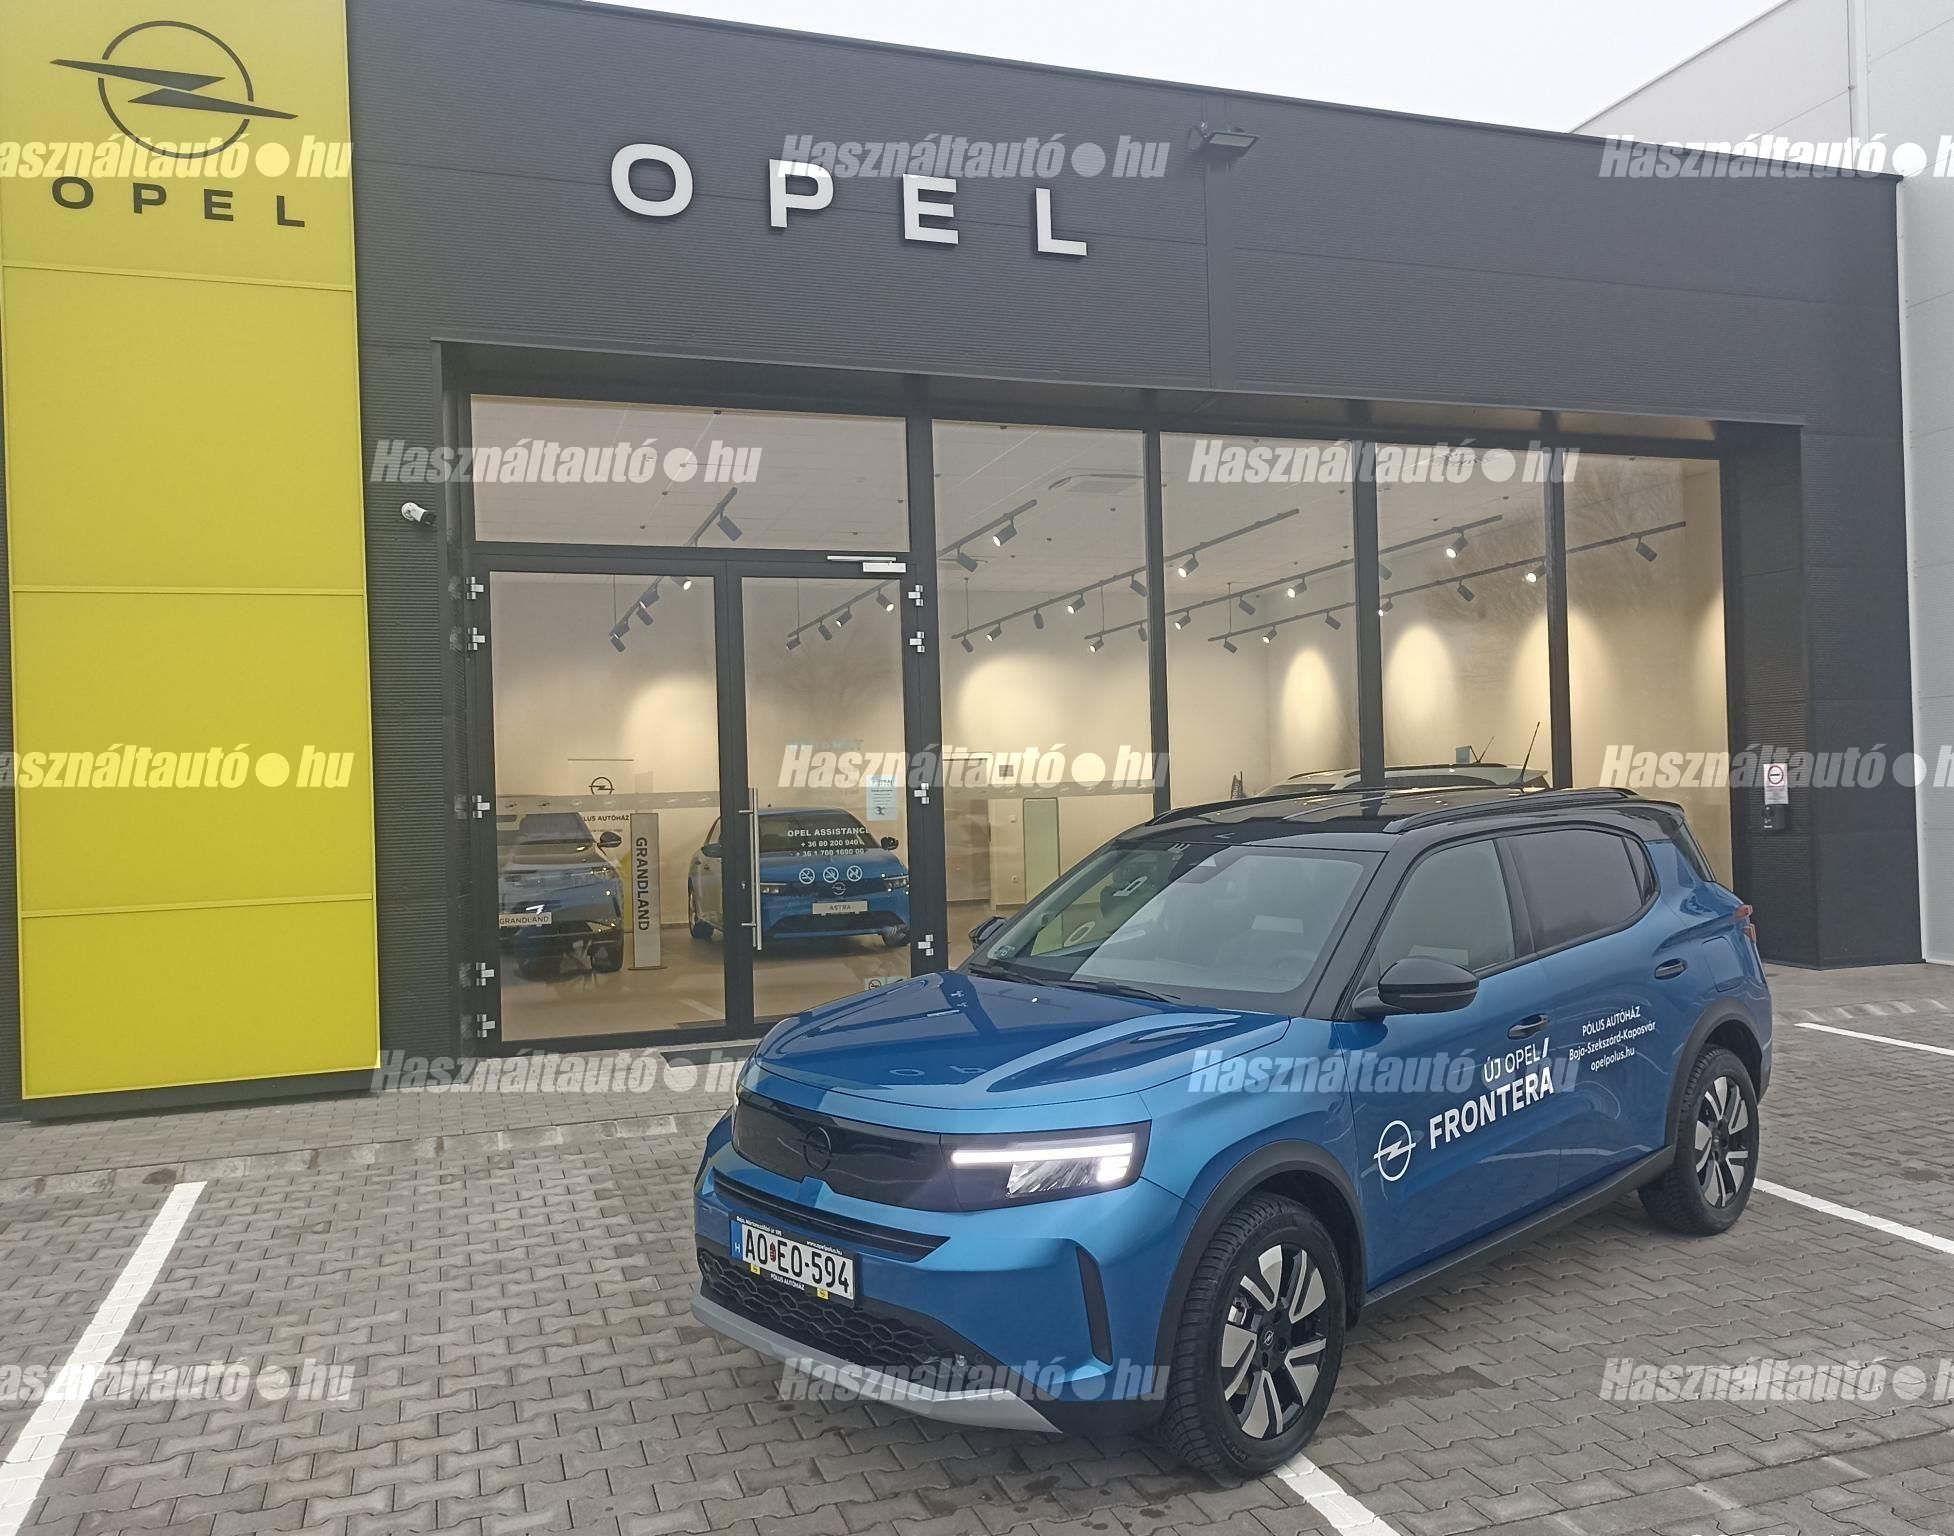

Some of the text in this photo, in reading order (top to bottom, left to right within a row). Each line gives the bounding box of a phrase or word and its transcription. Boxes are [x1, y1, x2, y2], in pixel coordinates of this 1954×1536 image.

[51, 175, 306, 228] OPEL
[610, 143, 1088, 256] OPEL
[787, 829, 812, 837] OPEL
[635, 836, 651, 931] GRANDLAND
[499, 916, 549, 926] GRANDLAND
[1582, 1005, 1641, 1037] PÓLUS AUTÓHÁZ
[1569, 1020, 1656, 1061] Baja-Szekszárd-Kaposvár
[1484, 1058, 1501, 1083] ÚJ
[1590, 1046, 1635, 1072] opelpolus.hu
[1429, 1067, 1555, 1150] FRONTERA
[734, 1241, 741, 1254] H
